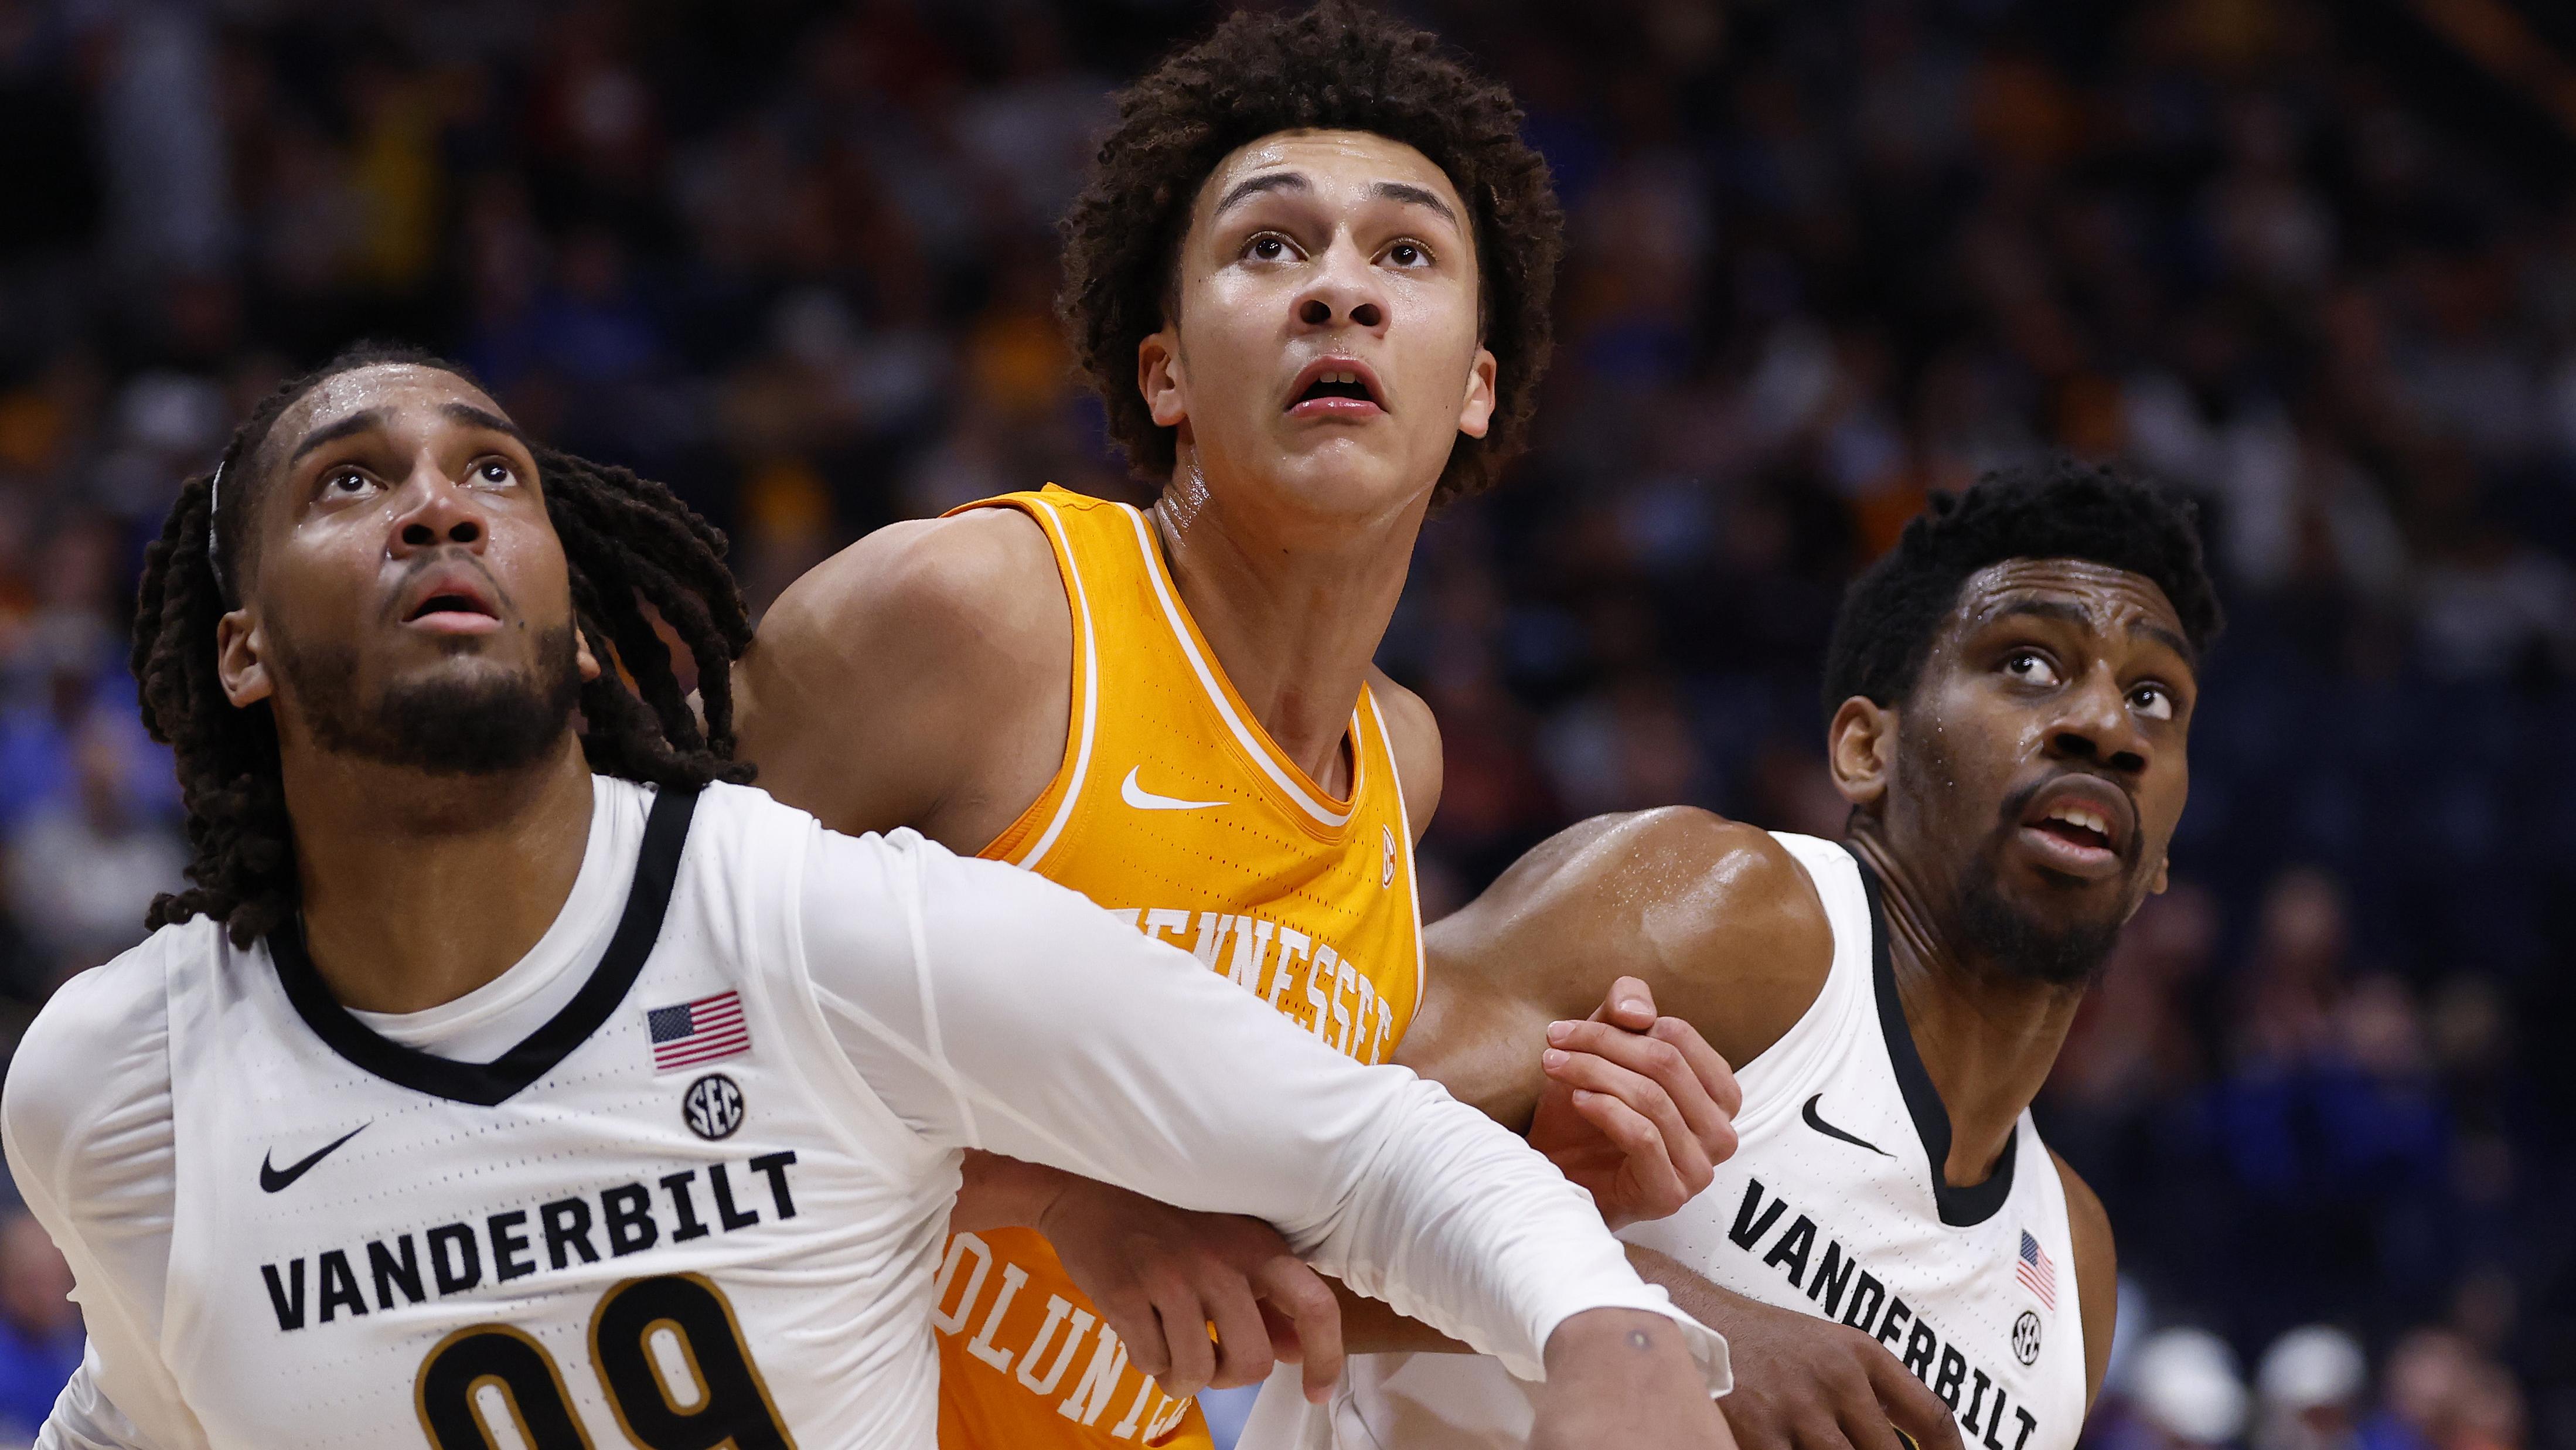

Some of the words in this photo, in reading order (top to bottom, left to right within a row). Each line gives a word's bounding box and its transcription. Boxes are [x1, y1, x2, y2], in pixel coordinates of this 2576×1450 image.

[1105, 908, 1393, 1066] NNESSEE
[686, 1078, 742, 1136] SEC
[261, 1151, 796, 1332] VANDERBILT
[1729, 1178, 2037, 1450] VANDERBILT
[2013, 1313, 2040, 1363] SEC
